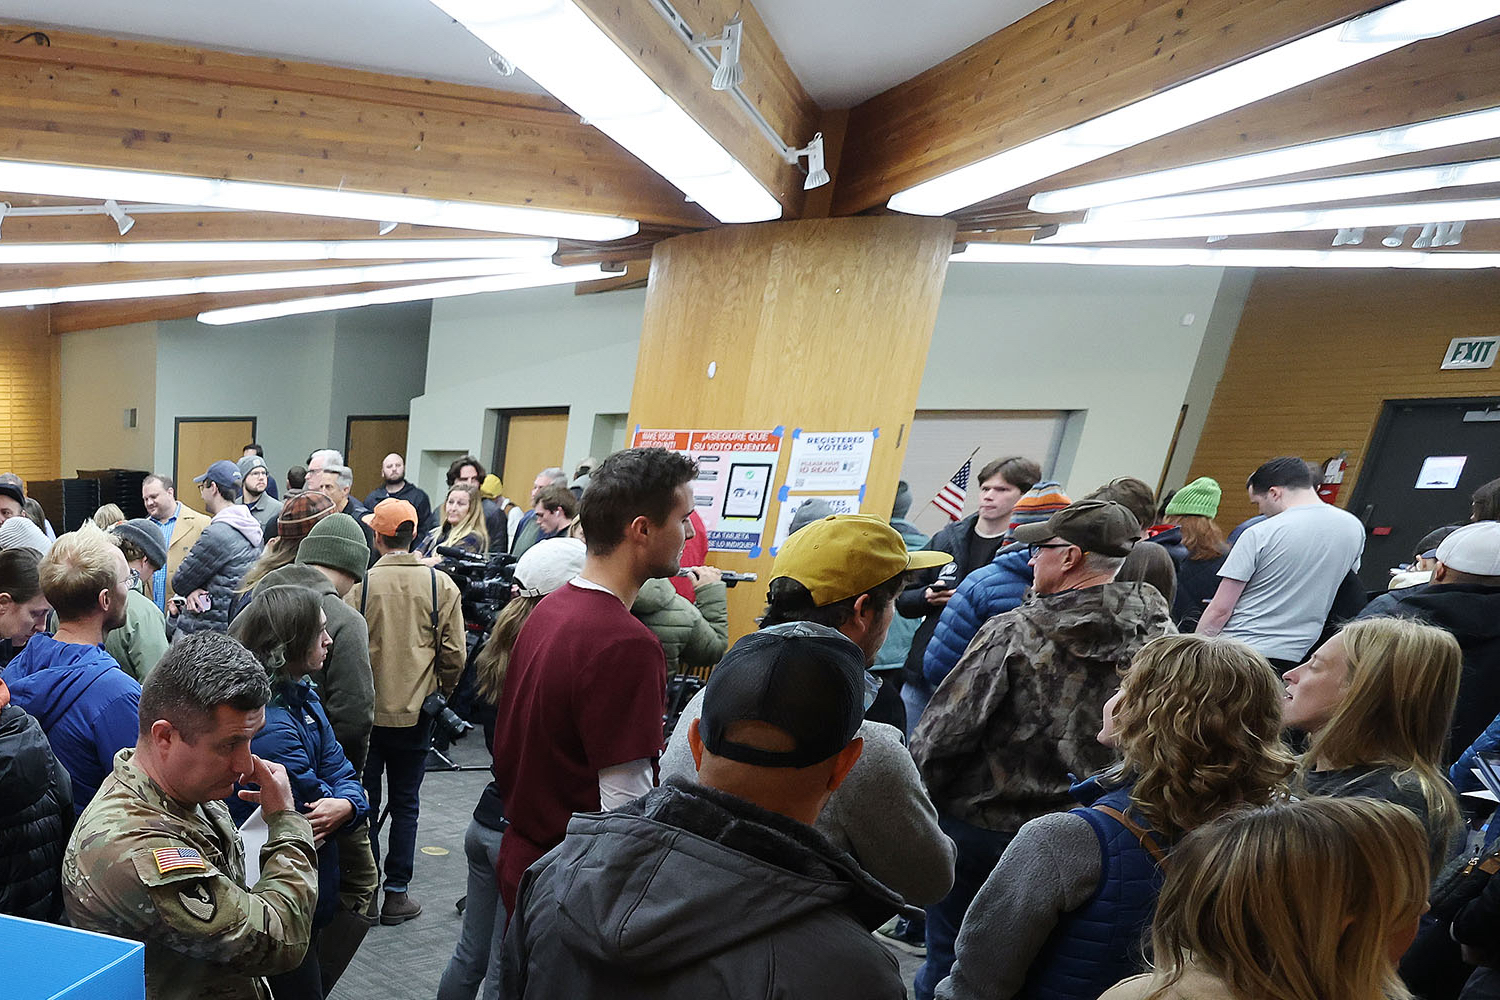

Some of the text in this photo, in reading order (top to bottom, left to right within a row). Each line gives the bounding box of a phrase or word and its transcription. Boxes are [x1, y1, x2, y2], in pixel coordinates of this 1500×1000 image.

[1451, 341, 1496, 362] EXIT
[659, 432, 675, 440] YOUR
[748, 432, 768, 441] QUE
[807, 436, 865, 444] REGISTERED
[693, 442, 775, 451] SU VOTO CUENTA!
[817, 443, 854, 451] VOTERS
[723, 532, 749, 540] TARJETA
